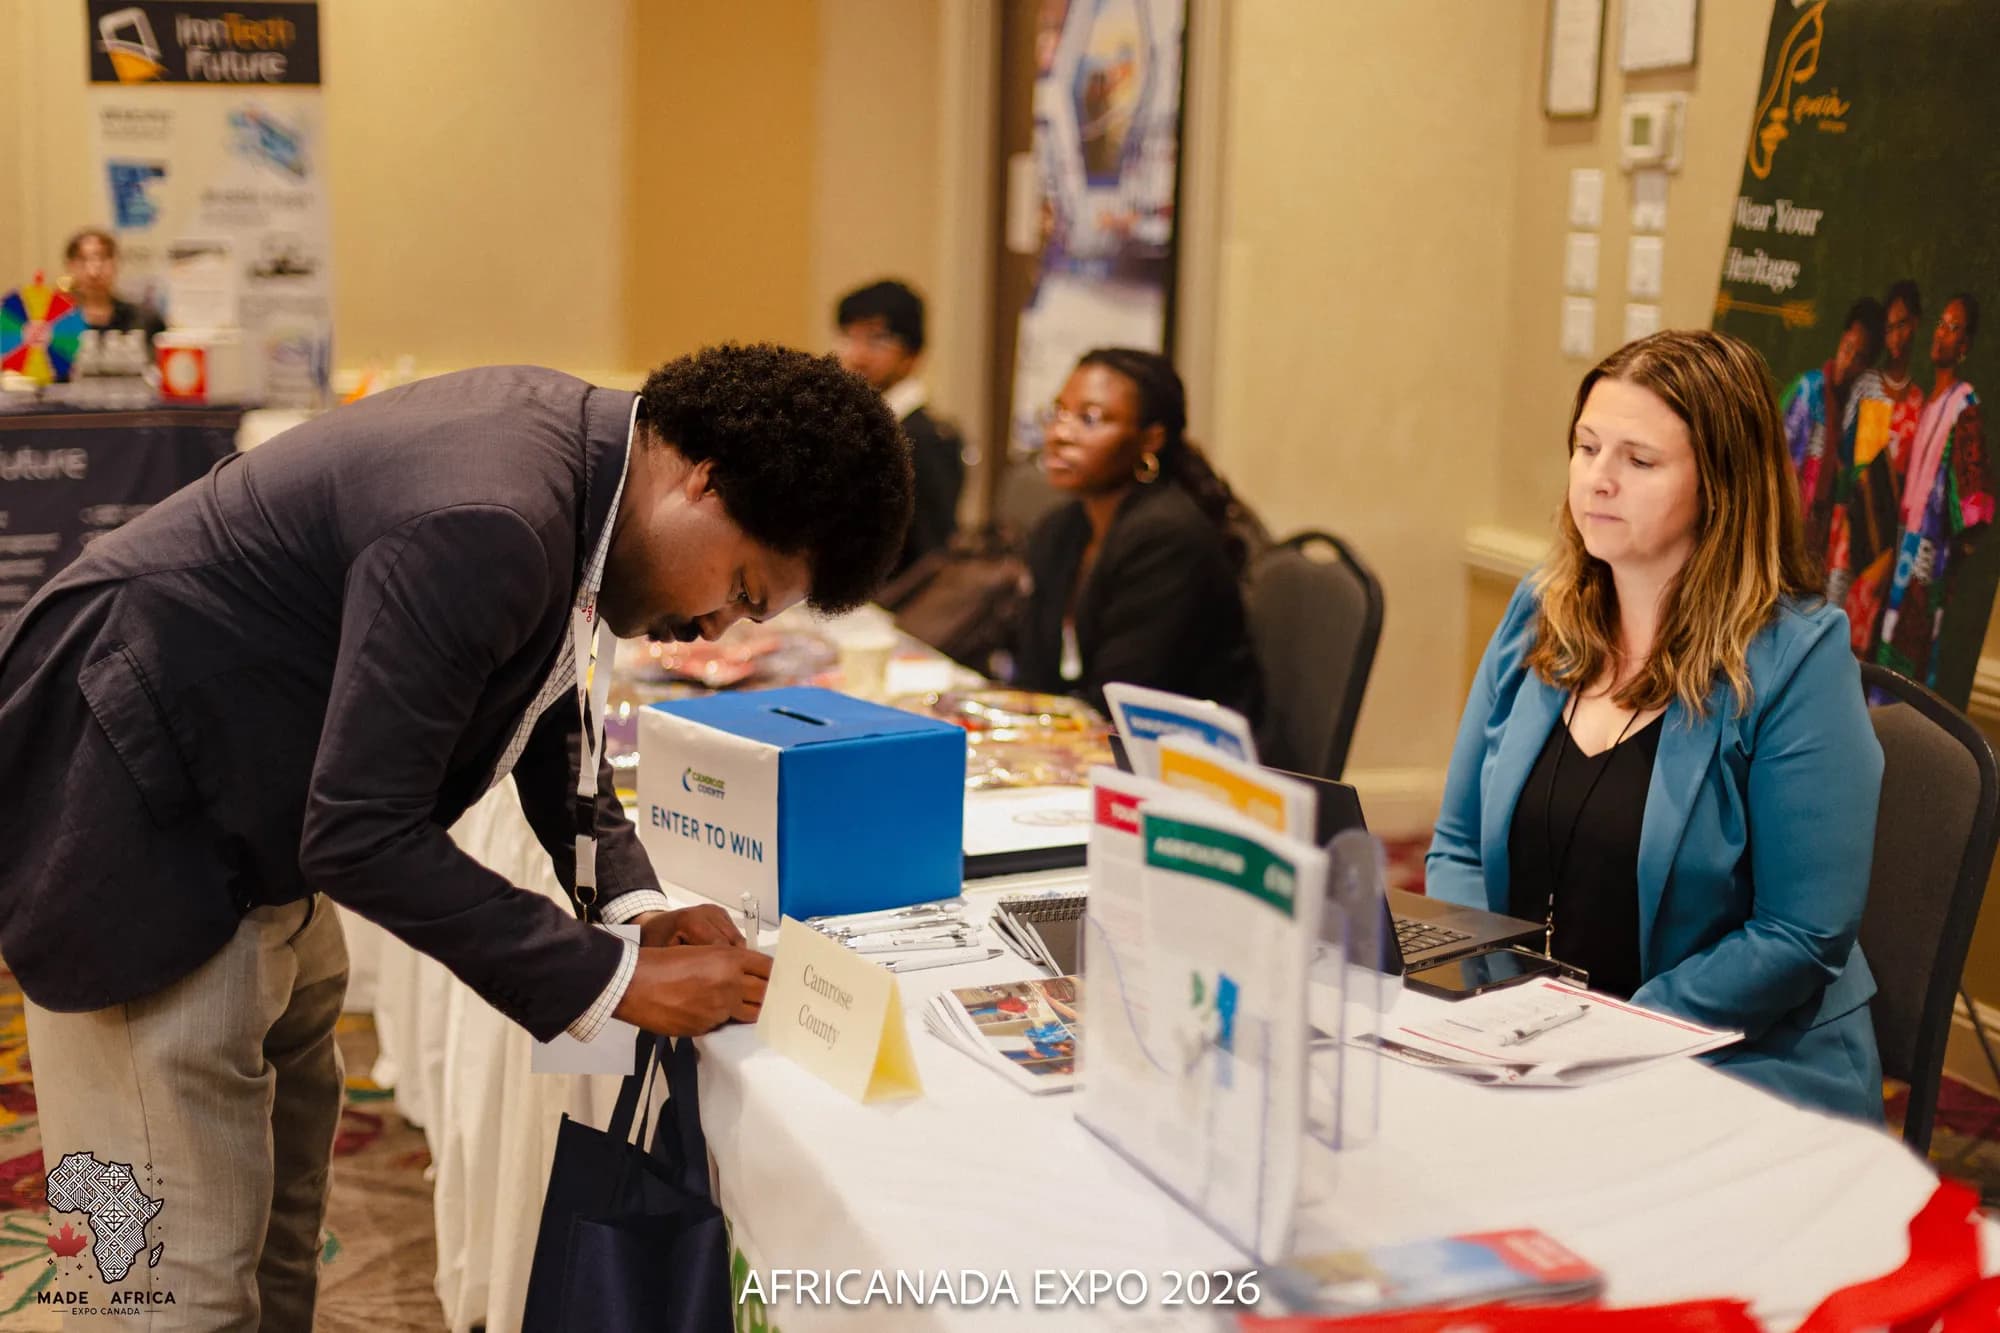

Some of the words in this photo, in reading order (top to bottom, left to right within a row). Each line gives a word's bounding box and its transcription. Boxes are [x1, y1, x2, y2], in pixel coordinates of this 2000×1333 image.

[185, 48, 289, 82] Future
[1775, 199, 1824, 237] Your
[0, 444, 89, 480] uture
[651, 804, 700, 842] ENTER
[704, 822, 726, 850] TO
[730, 831, 763, 863] WIN
[803, 963, 853, 1010] Camrose
[798, 1003, 840, 1050] County
